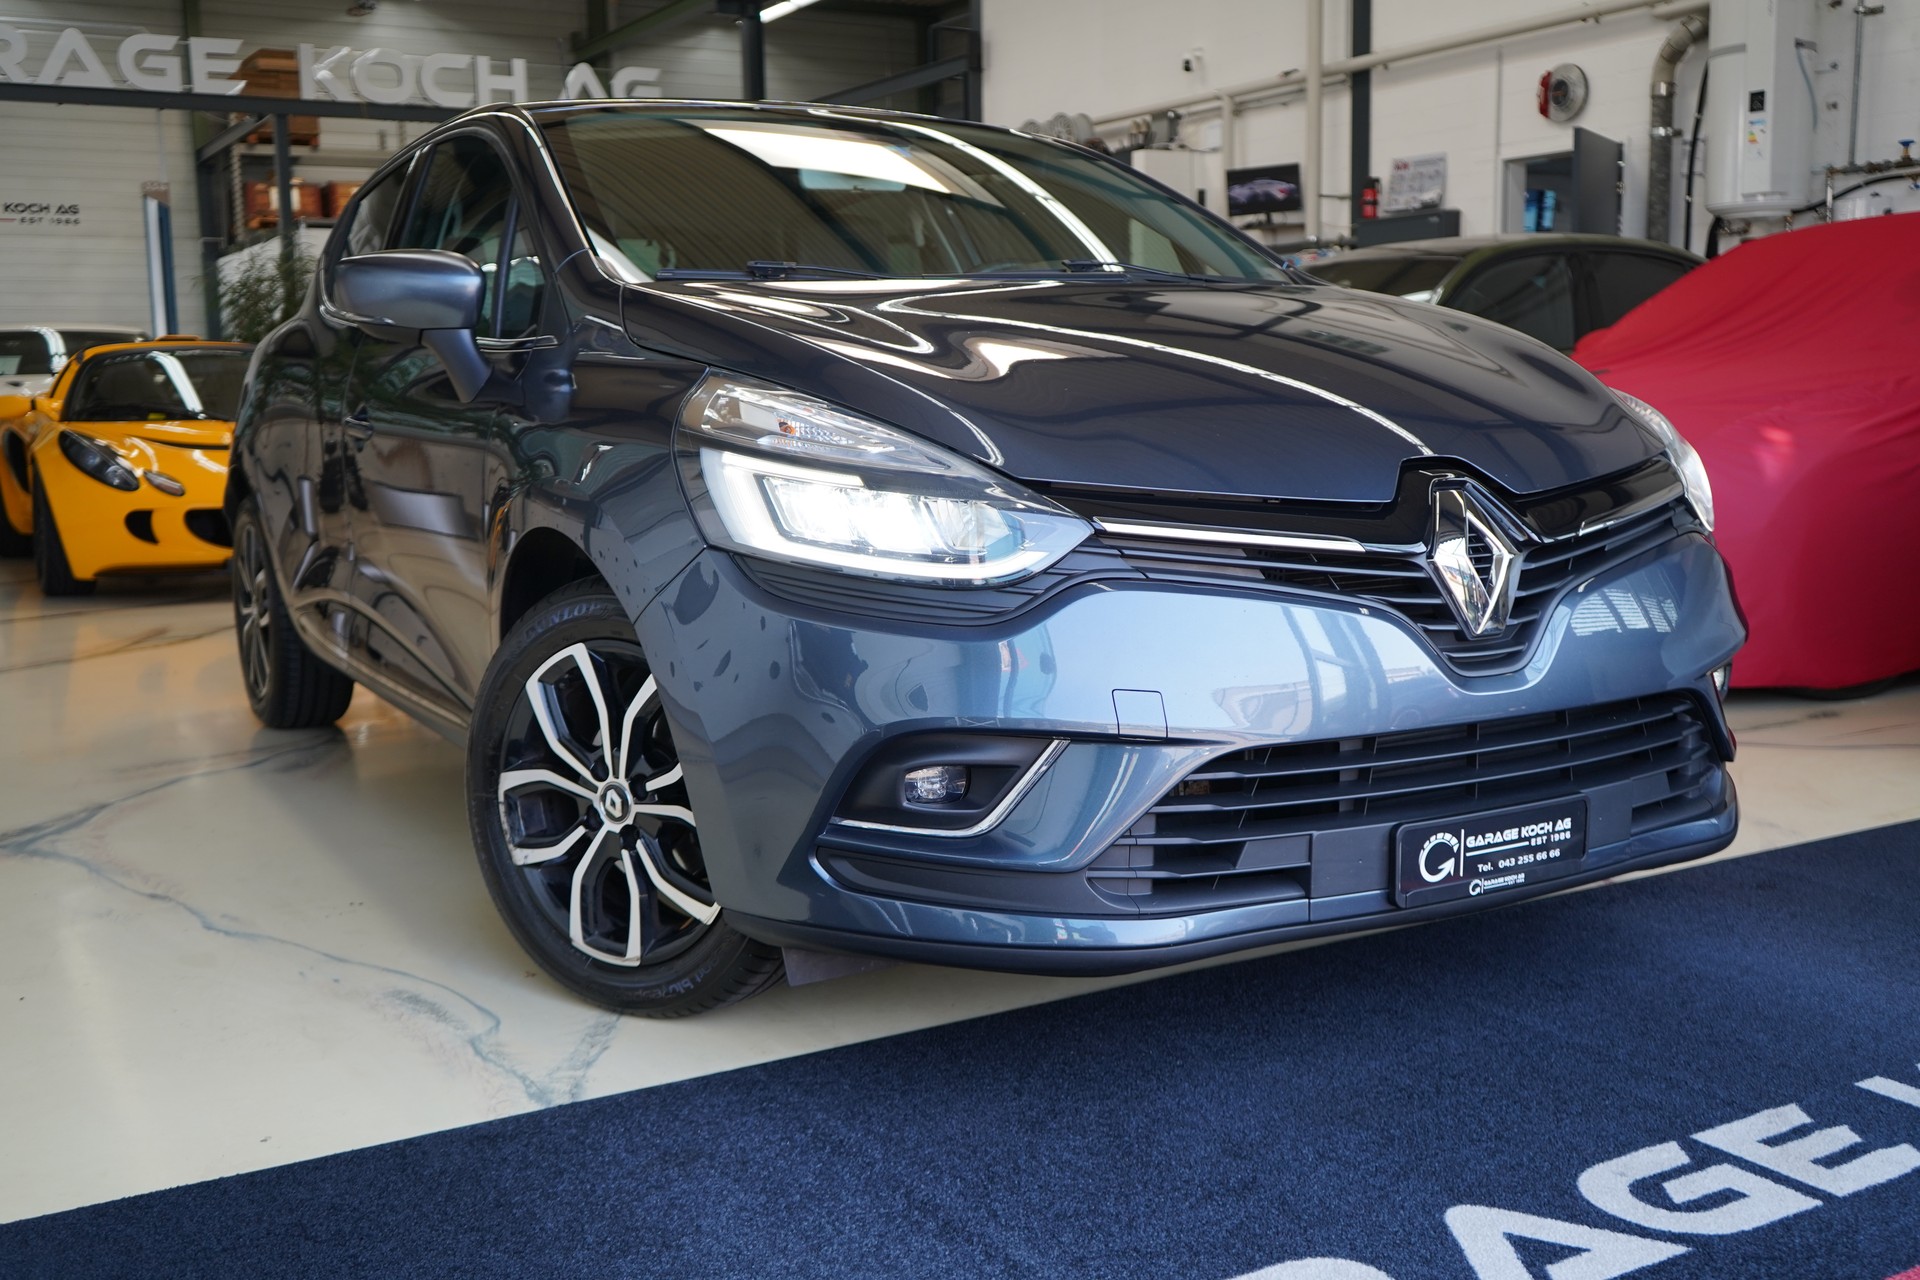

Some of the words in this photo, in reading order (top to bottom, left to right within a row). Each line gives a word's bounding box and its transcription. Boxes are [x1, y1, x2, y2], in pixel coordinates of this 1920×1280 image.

[298, 43, 528, 108] KOCH
[557, 62, 662, 99] AG
[3, 202, 50, 214] KOCH
[55, 204, 80, 215] AG
[524, 603, 602, 641] DUNLOP
[1465, 828, 1519, 849] GARAGE
[1521, 821, 1553, 839] KOCH
[1554, 817, 1572, 832] AG
[1530, 836, 1547, 847] EST
[1550, 831, 1571, 843] 1986
[1477, 862, 1494, 873] Tel.
[1498, 857, 1516, 869] 043
[1517, 853, 1535, 865] 255
[1536, 850, 1548, 861] 66
[1549, 848, 1561, 858] 66
